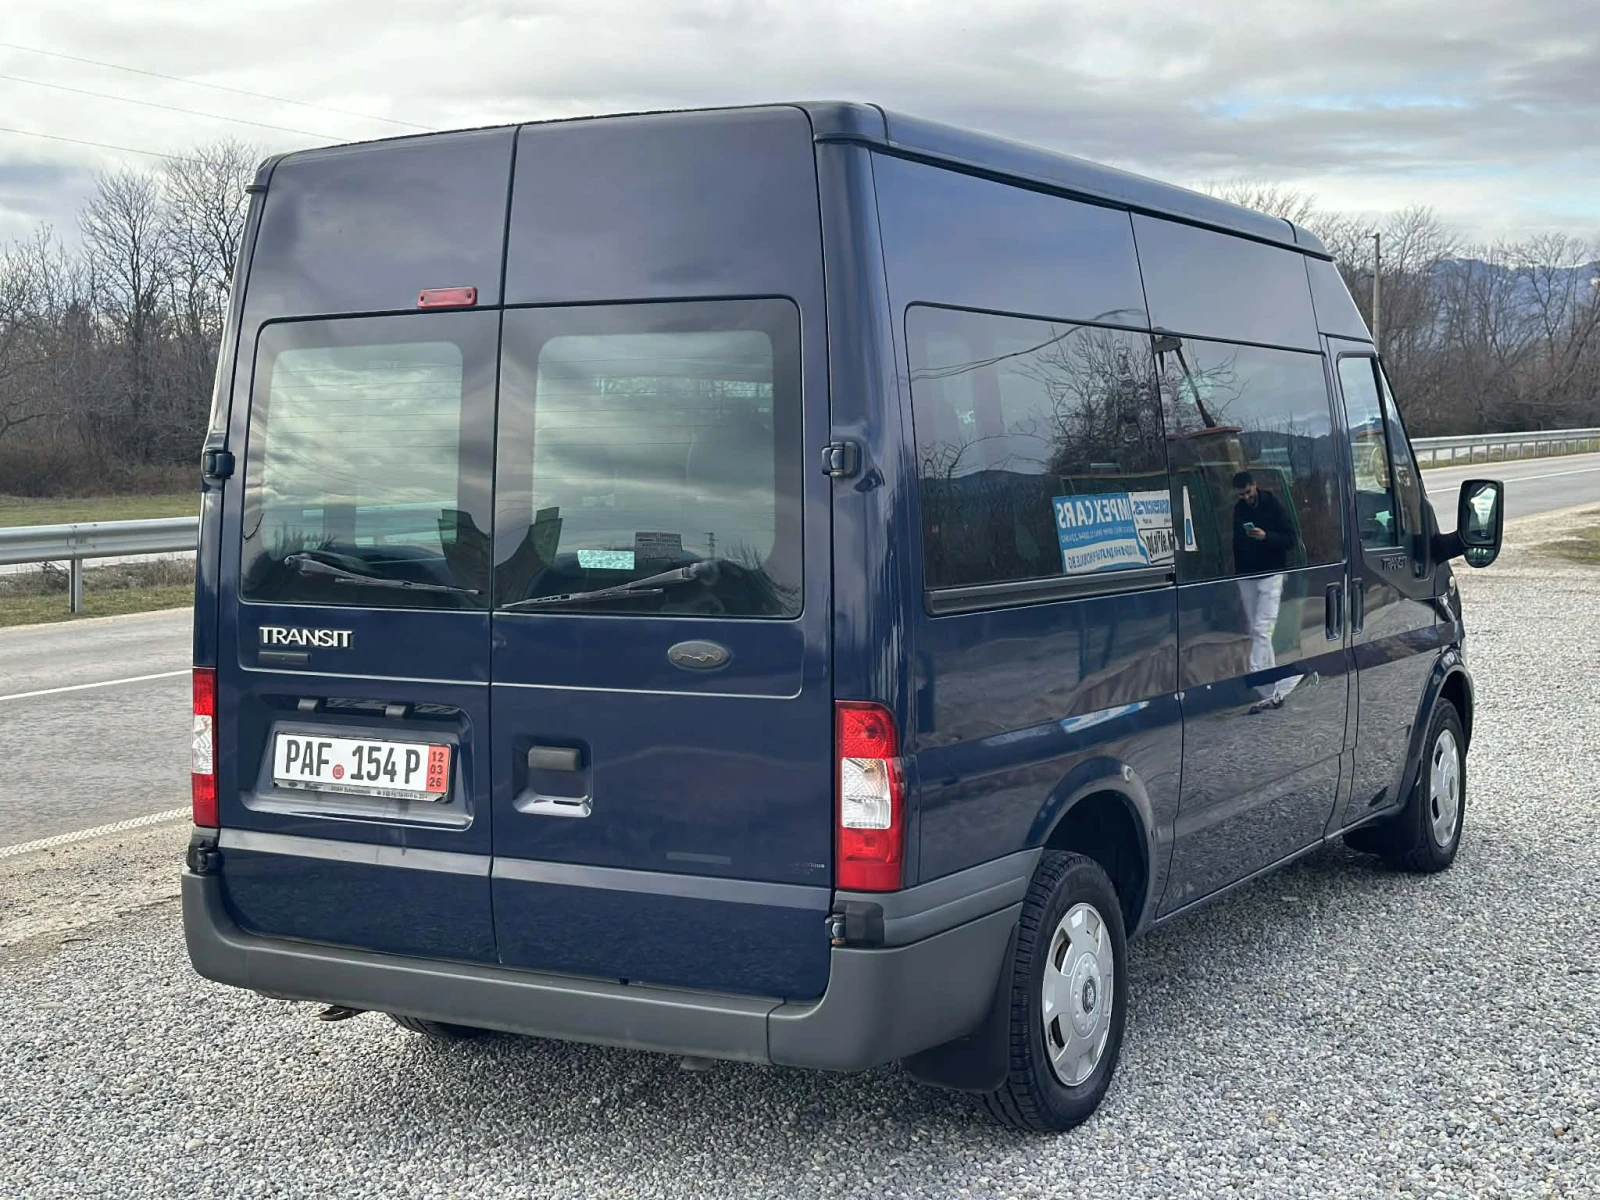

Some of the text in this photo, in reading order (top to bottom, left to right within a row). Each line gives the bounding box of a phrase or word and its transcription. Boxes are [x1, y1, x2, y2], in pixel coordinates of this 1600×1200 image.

[259, 626, 353, 648] TRANSIT
[285, 739, 421, 785] PAF 154 P
[432, 750, 444, 763] 12
[430, 763, 443, 775] 03
[429, 776, 442, 788] 26
